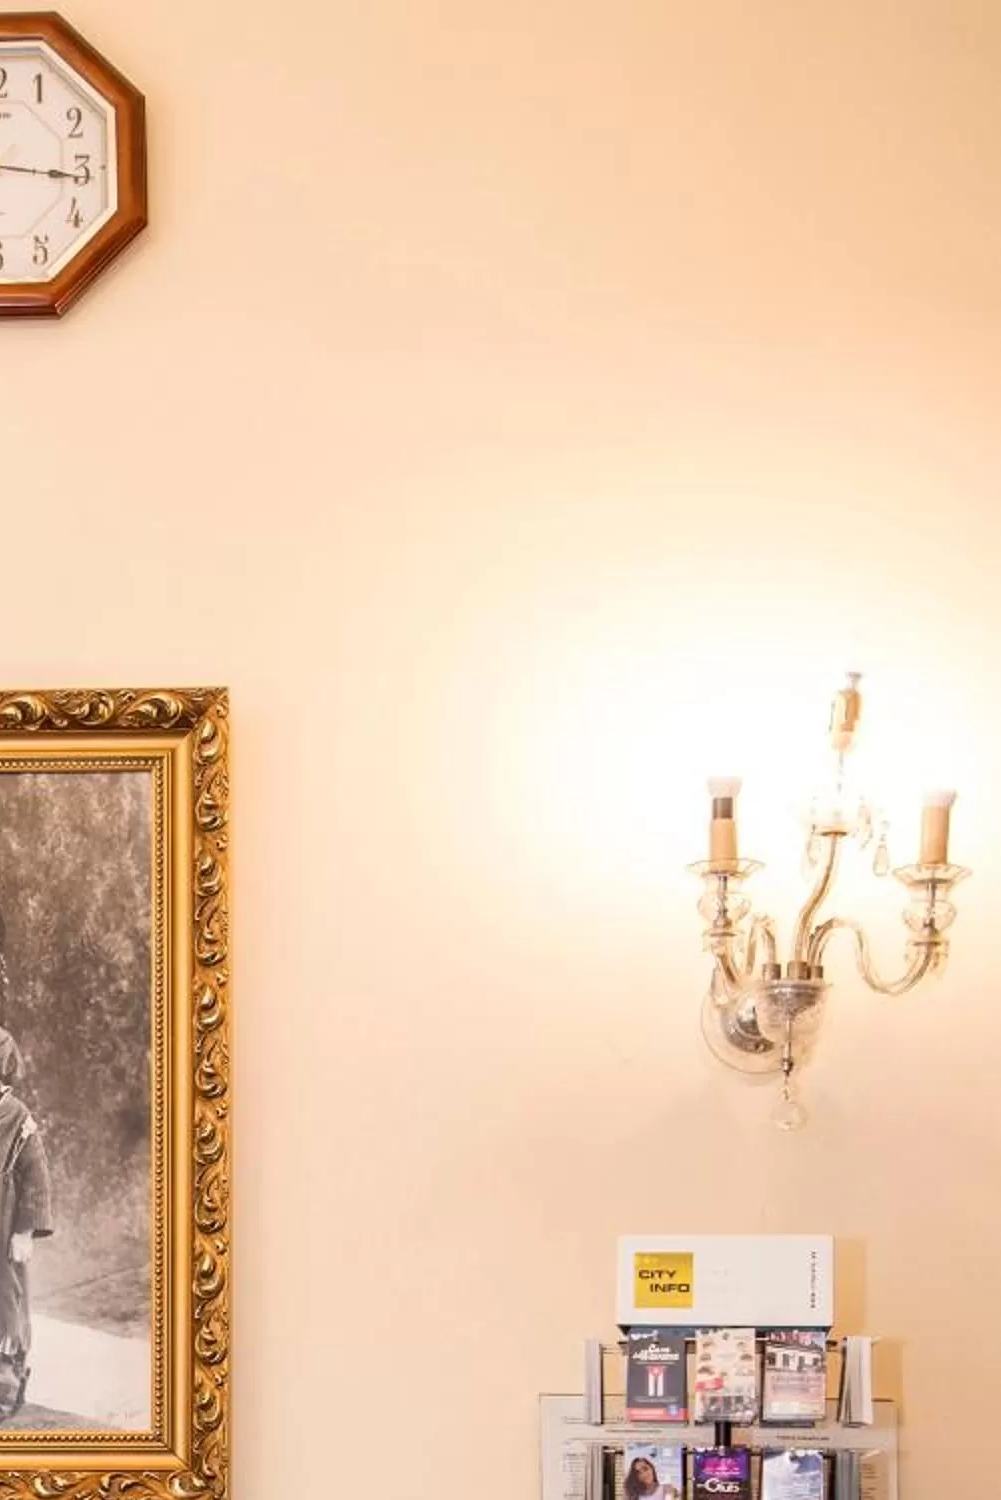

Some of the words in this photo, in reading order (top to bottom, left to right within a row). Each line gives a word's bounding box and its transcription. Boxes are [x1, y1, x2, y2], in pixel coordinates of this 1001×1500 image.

[33, 73, 43, 103] 1
[66, 108, 83, 138] 2
[74, 155, 90, 185] 3
[66, 197, 84, 228] 4
[33, 235, 48, 265] 5
[638, 1269, 676, 1280] CITY
[650, 1283, 690, 1293] INFO
